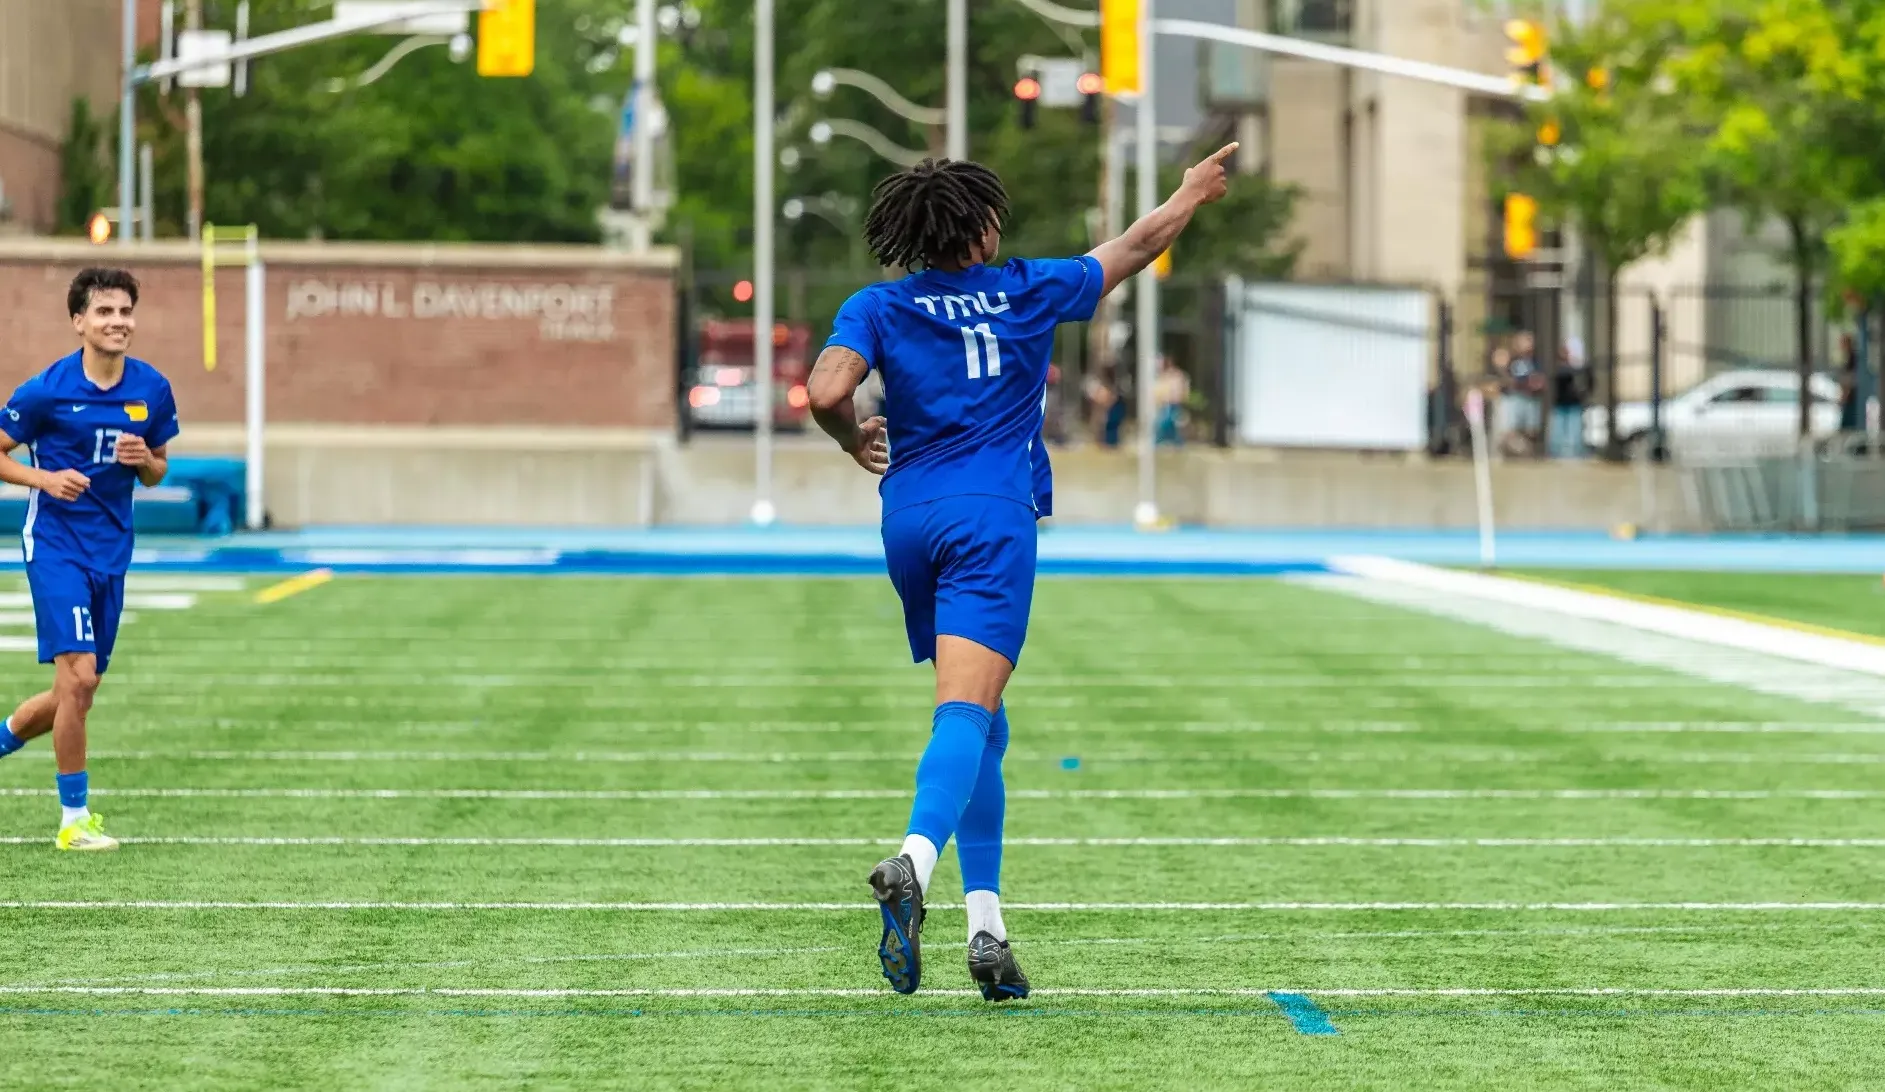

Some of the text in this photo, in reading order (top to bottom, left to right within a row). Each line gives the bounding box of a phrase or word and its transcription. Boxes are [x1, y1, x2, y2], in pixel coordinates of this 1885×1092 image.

[285, 280, 615, 320] JOHN L DAVENPORT
[914, 291, 1011, 320] TMU
[961, 322, 1001, 379] 11
[93, 428, 122, 464] 13
[72, 606, 95, 641] 13
